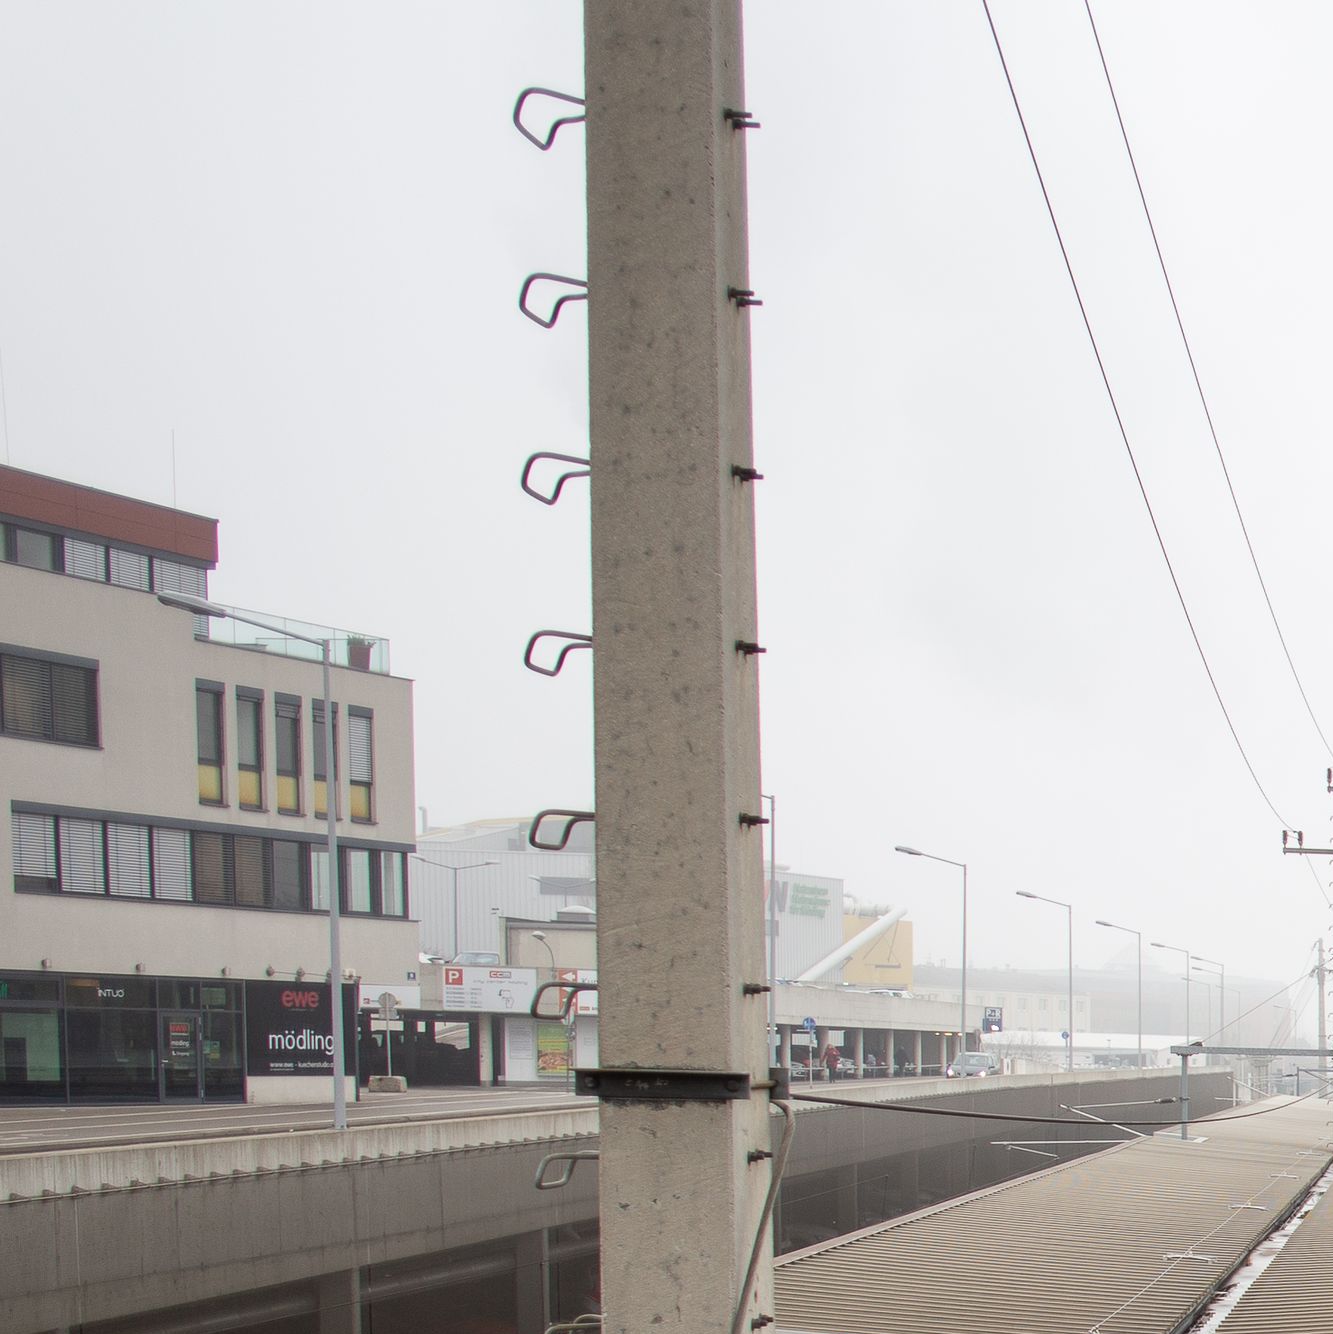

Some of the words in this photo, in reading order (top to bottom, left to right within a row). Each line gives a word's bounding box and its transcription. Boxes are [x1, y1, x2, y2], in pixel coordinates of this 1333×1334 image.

[448, 971, 459, 983] P
[281, 990, 319, 1008] ewe
[268, 1029, 334, 1055] mödling
